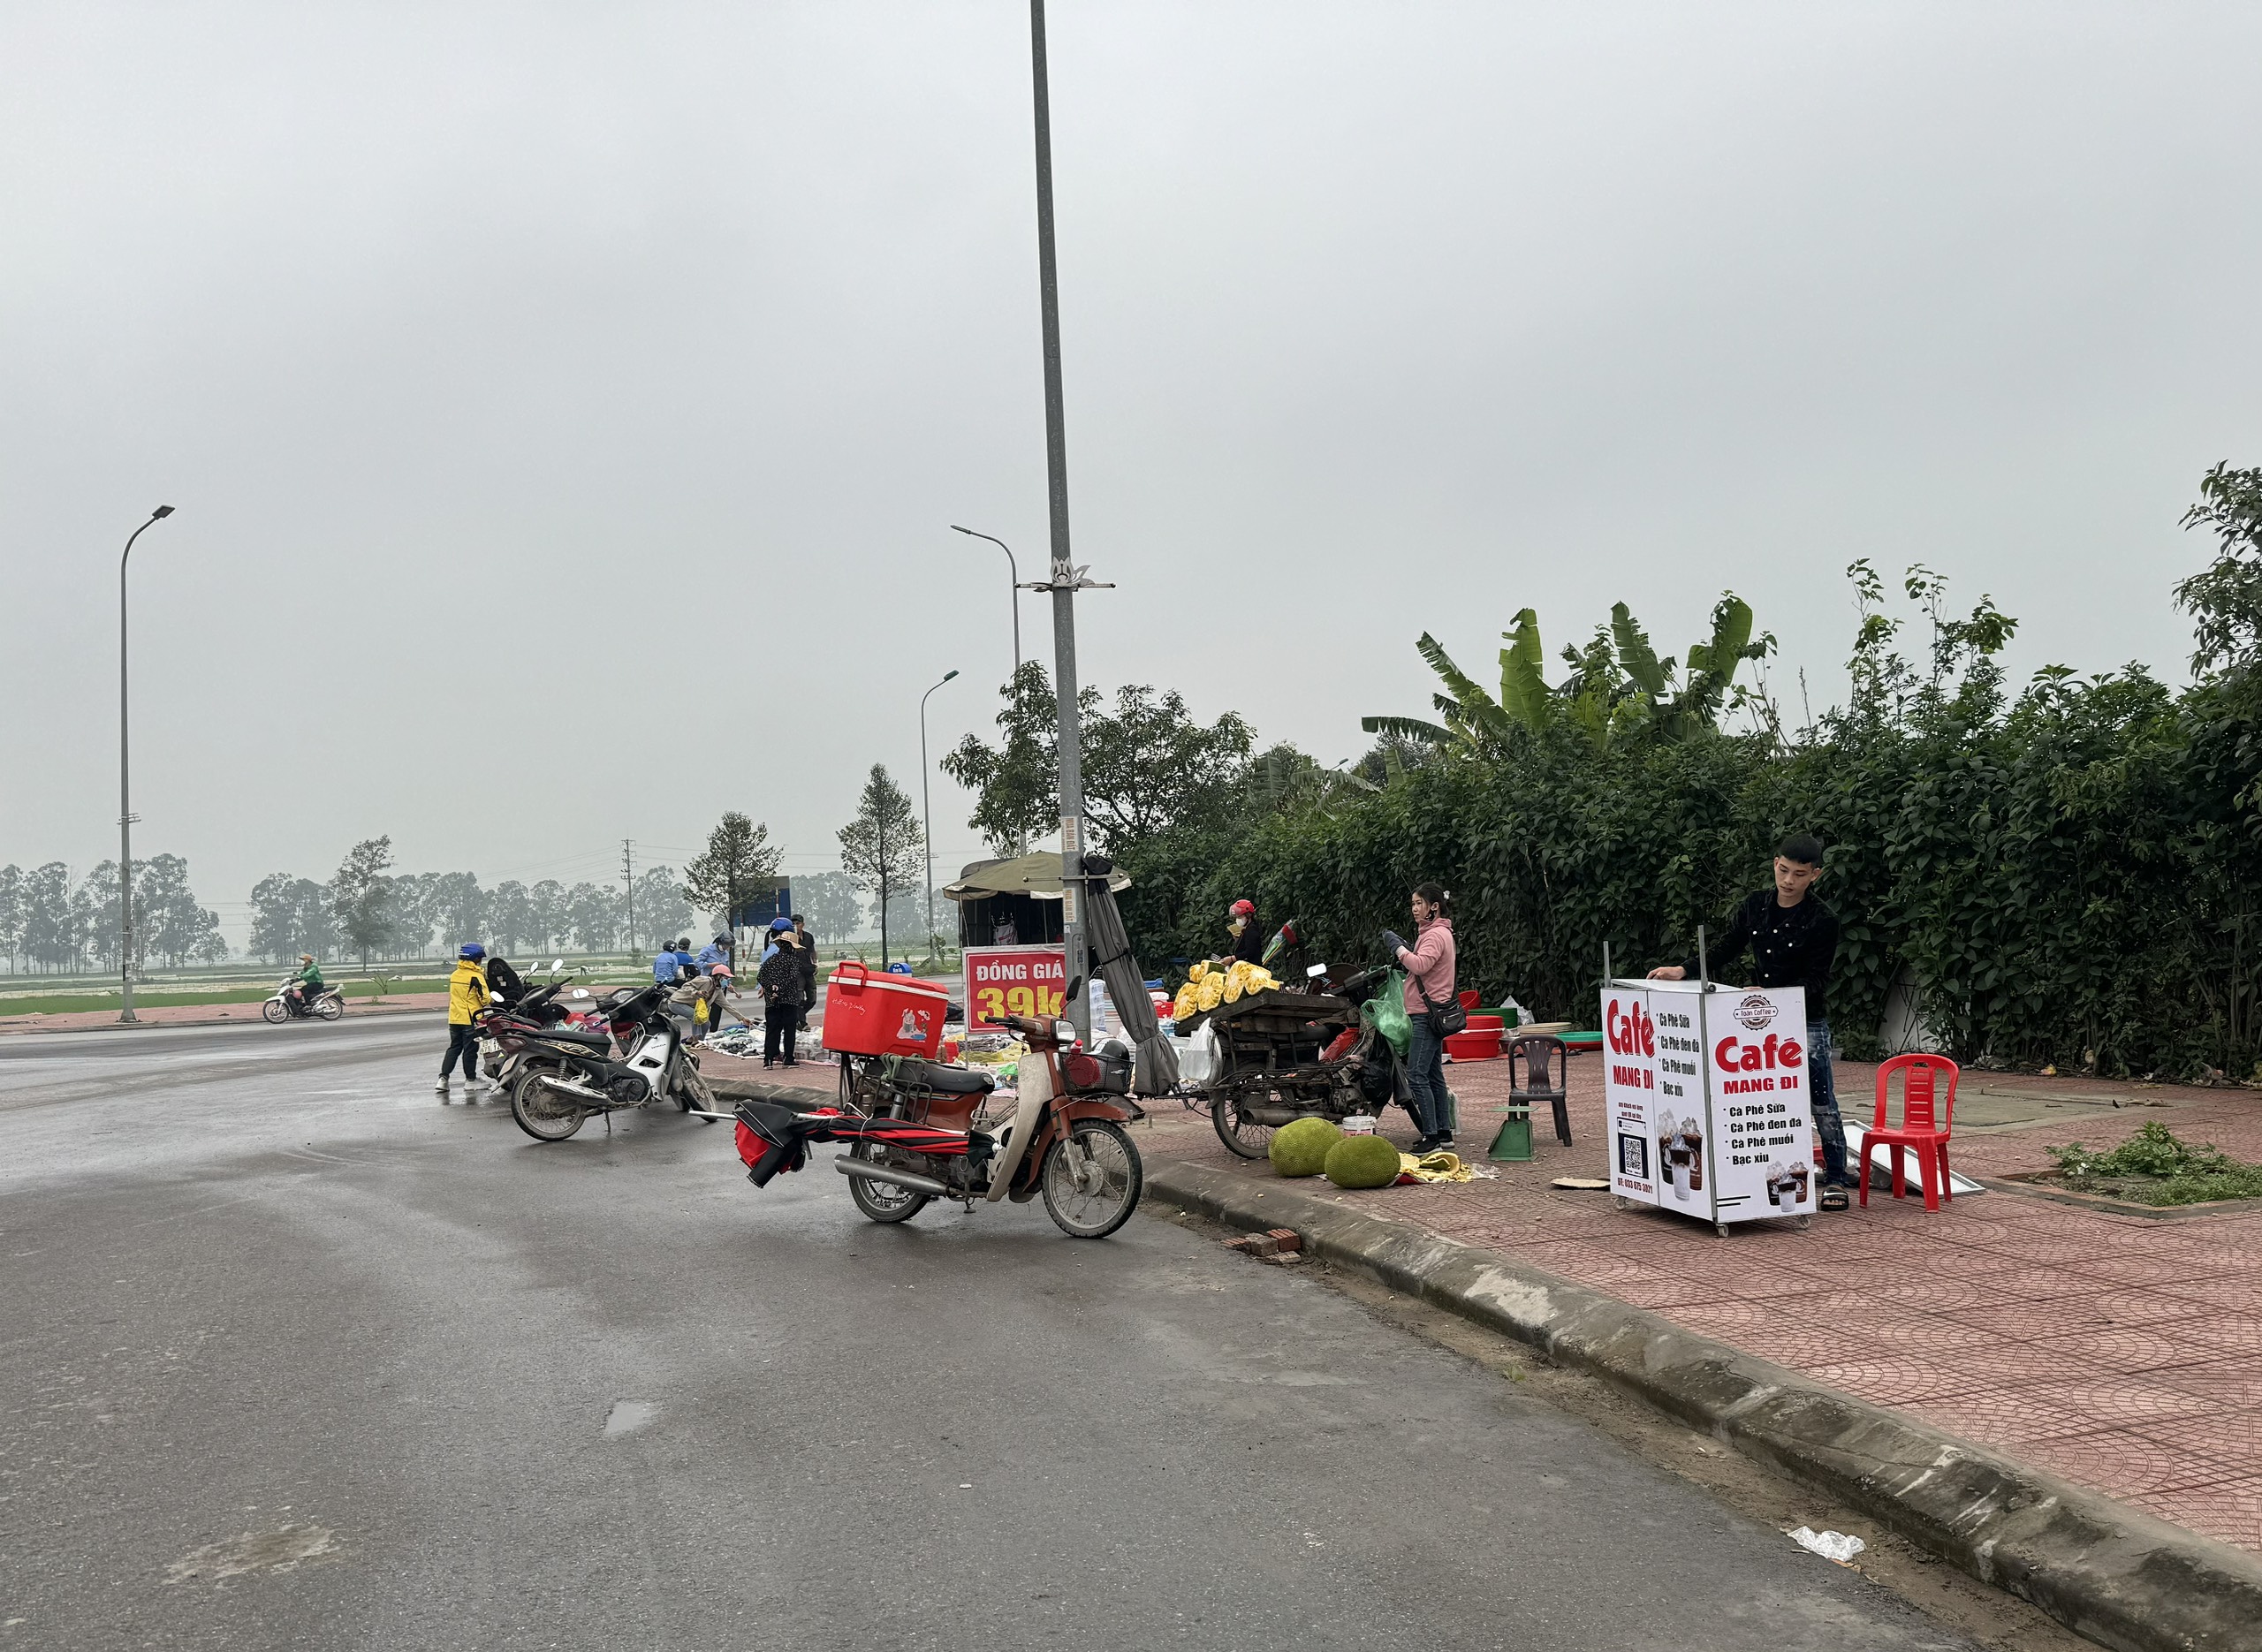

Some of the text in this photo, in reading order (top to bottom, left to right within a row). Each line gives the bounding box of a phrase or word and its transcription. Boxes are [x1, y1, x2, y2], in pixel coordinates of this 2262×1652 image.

[976, 959, 1064, 981] ĐỒNG GIÁ
[977, 985, 1065, 1023] 39k
[1607, 998, 1655, 1058] Café
[1715, 1033, 1803, 1073] Café
[1613, 1065, 1654, 1089] MANG ĐI
[1723, 1075, 1798, 1095] MANG ĐI
[1729, 1106, 1742, 1117] Cà
[1745, 1104, 1764, 1116] Phê
[1730, 1117, 1802, 1133] Cà Phê đen đá
[1731, 1138, 1744, 1149] Cà
[1747, 1136, 1765, 1148] Phê
[1732, 1155, 1751, 1166] Bạc
